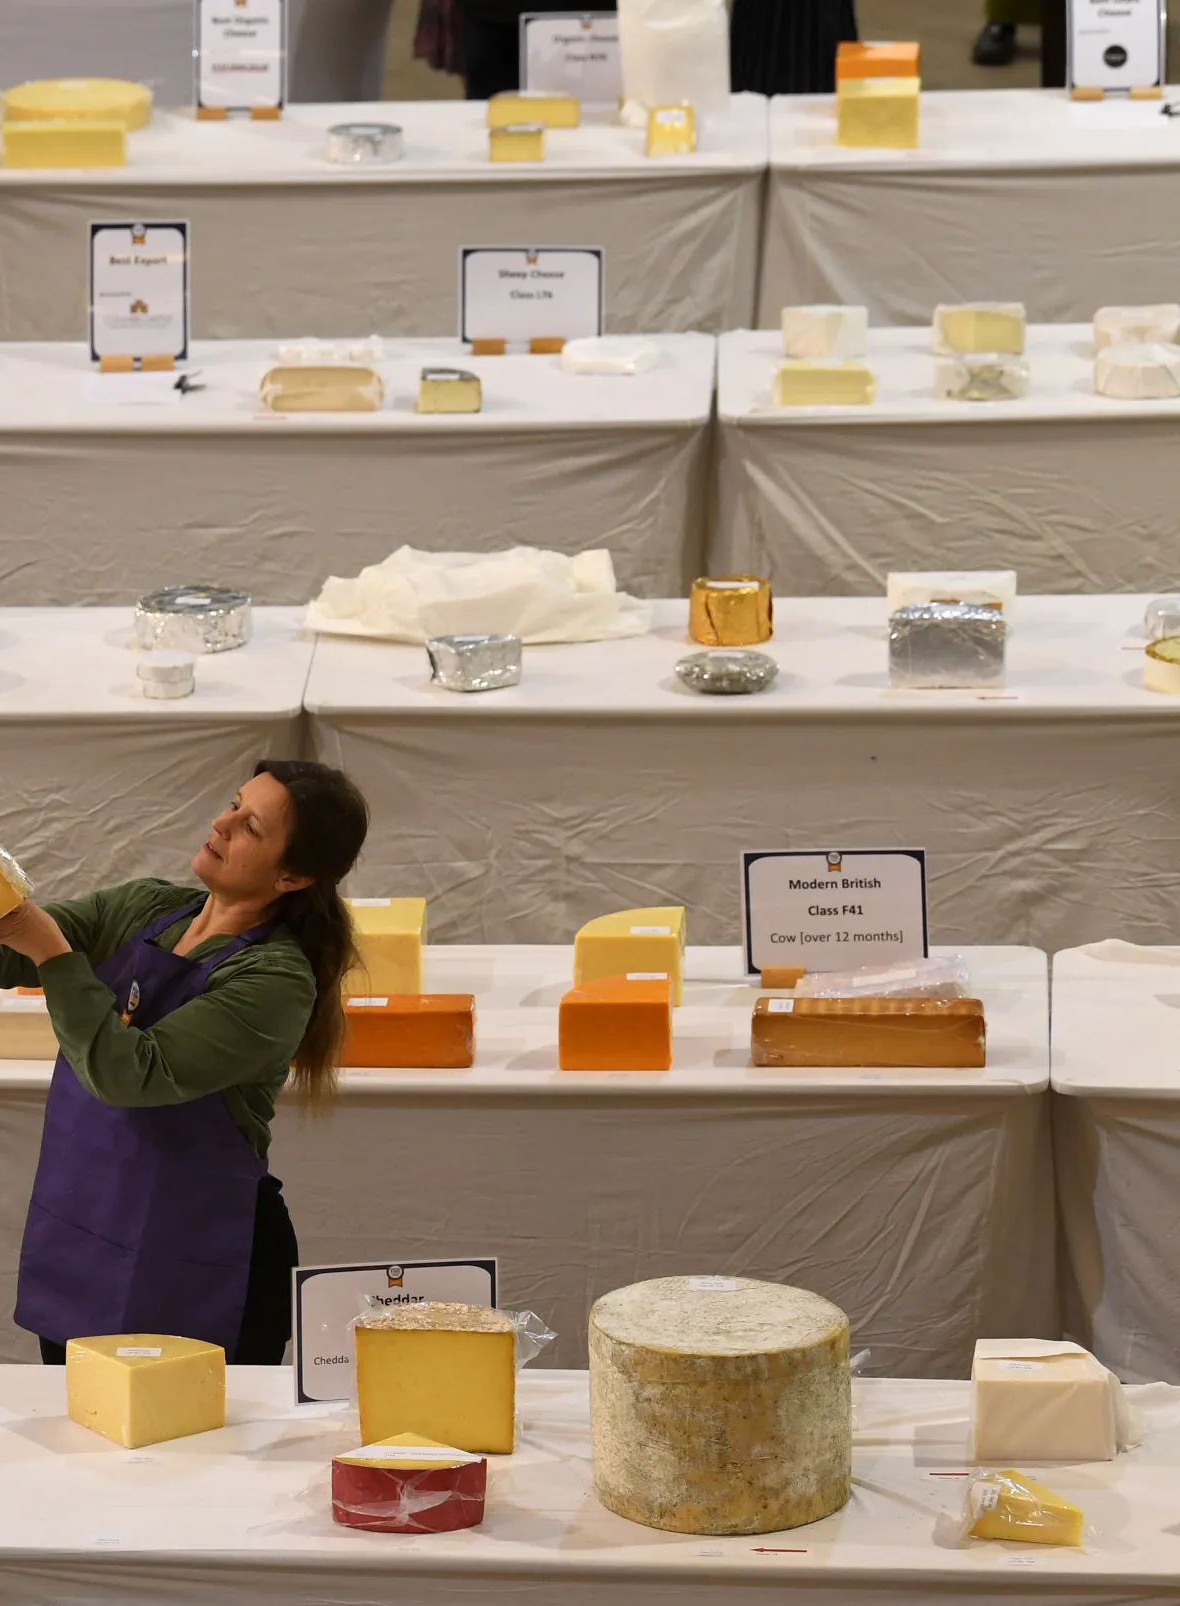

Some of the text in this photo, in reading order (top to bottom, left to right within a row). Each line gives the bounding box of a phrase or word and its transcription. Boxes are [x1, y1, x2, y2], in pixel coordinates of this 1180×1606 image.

[109, 255, 168, 268] Best Export
[510, 290, 534, 299] Class
[789, 878, 881, 890] Modern British
[808, 905, 864, 916] Class F41
[770, 930, 903, 945] Cow [over 12 months]
